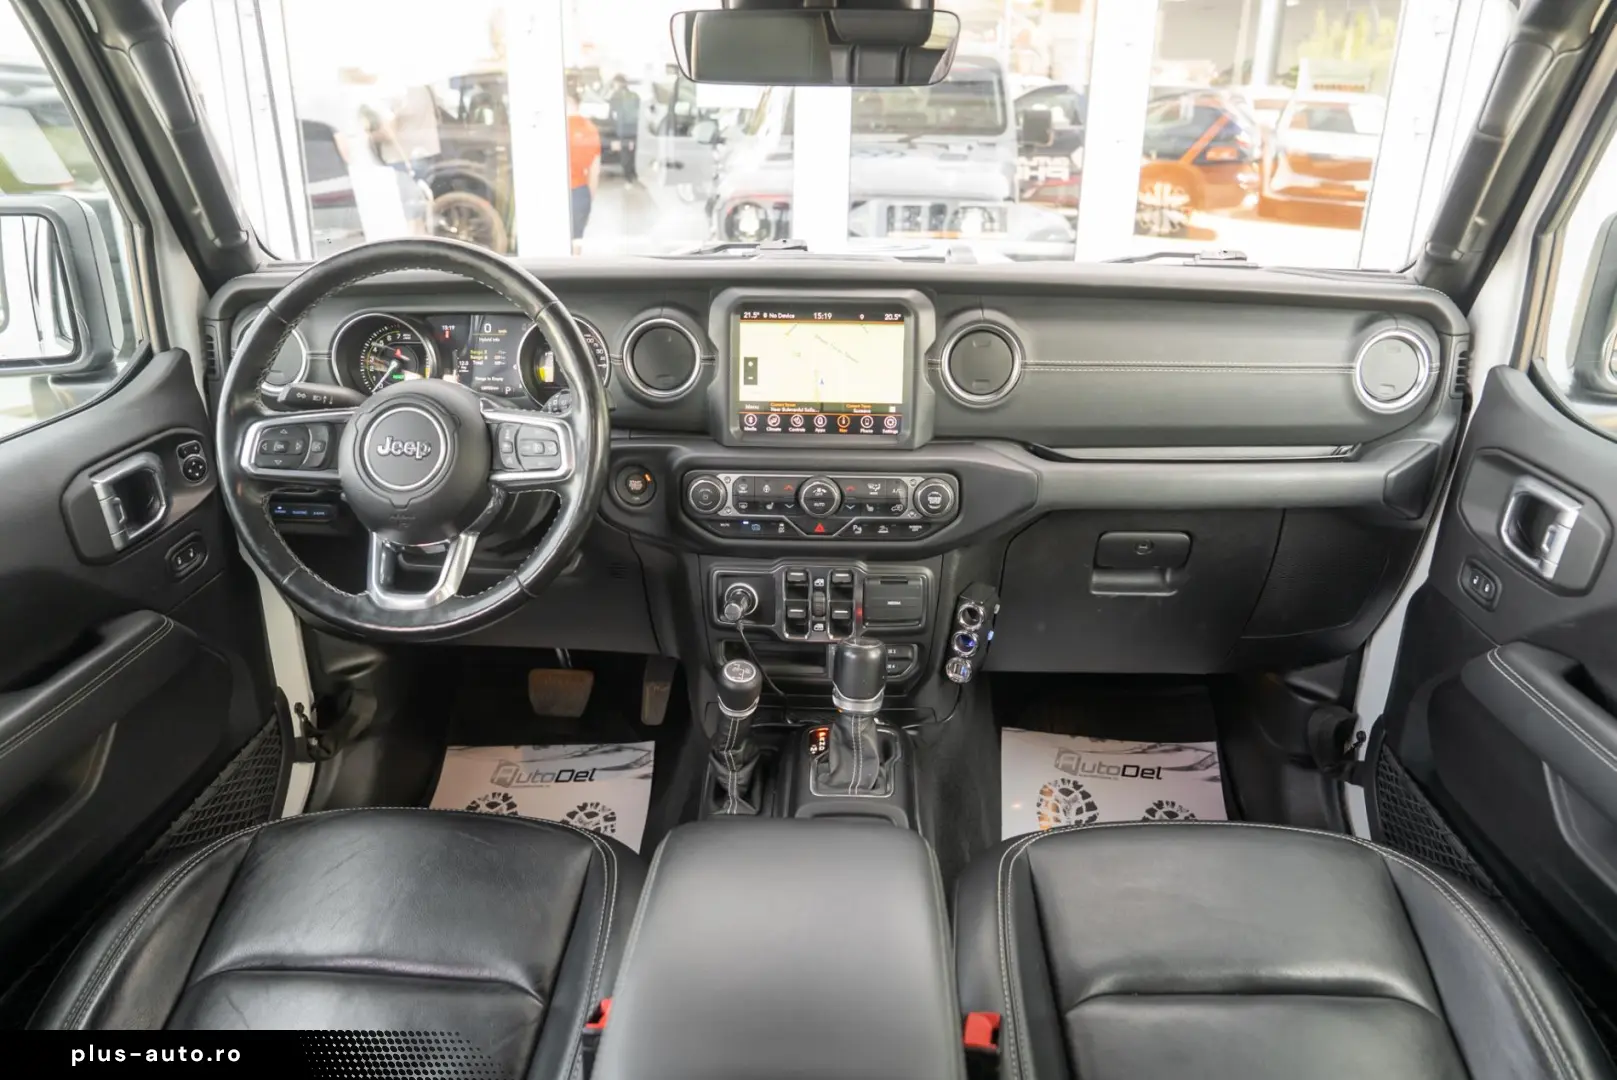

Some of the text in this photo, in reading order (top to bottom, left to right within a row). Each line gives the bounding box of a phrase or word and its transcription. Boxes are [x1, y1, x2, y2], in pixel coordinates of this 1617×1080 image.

[483, 323, 492, 333] 0
[813, 312, 833, 320] 15:19
[376, 435, 432, 460] Jeep
[491, 760, 597, 788] AutoDel
[1054, 746, 1162, 781] AutoDel
